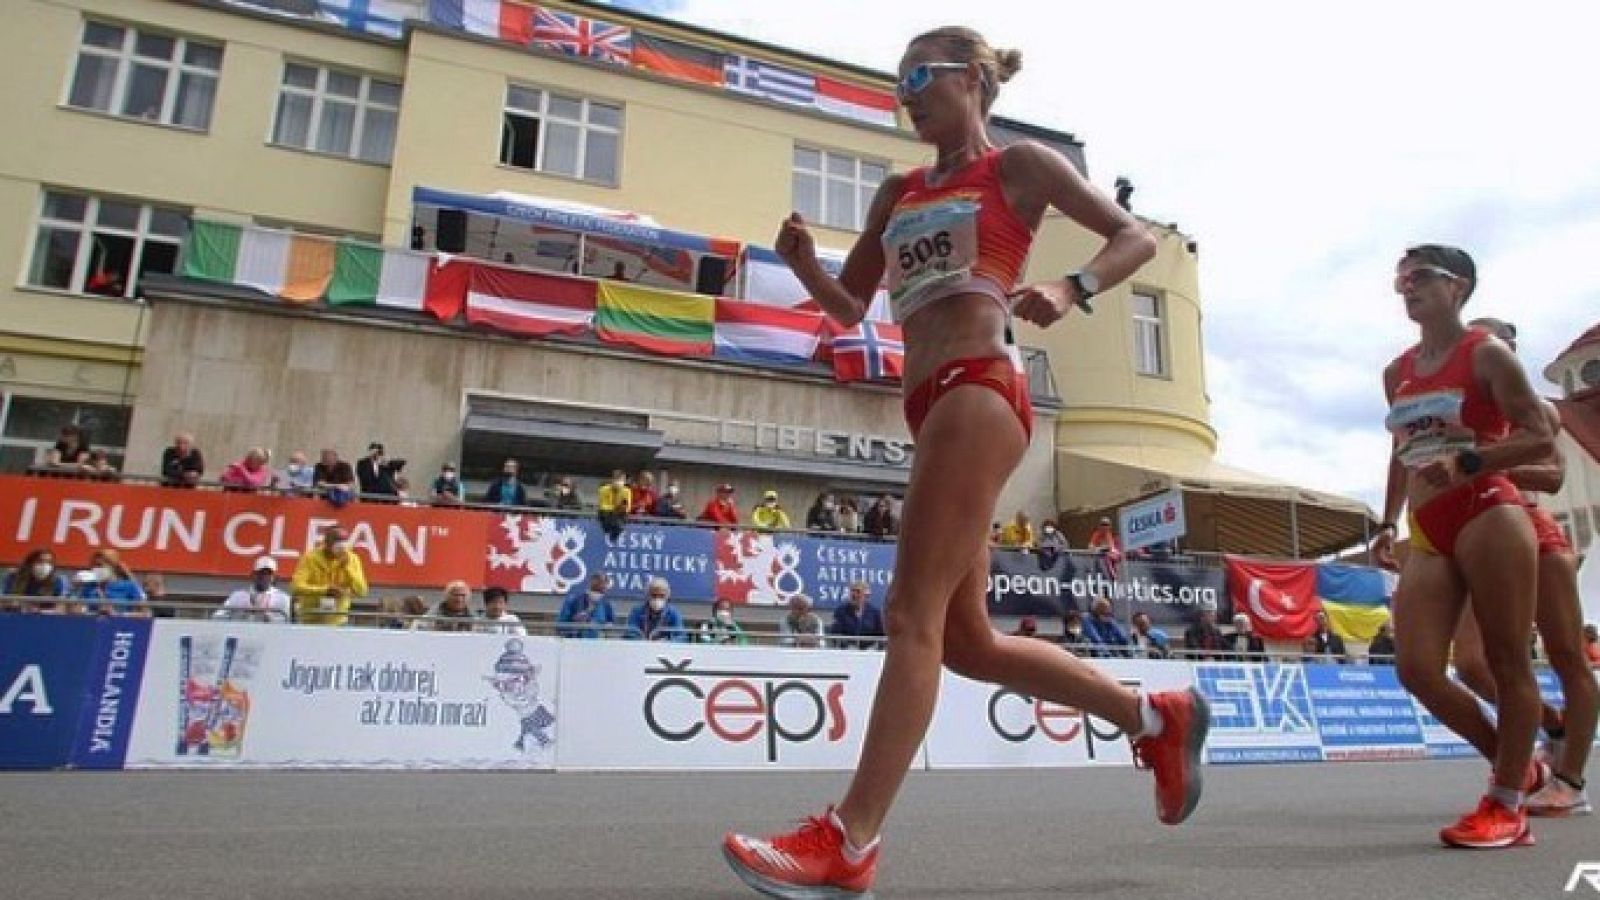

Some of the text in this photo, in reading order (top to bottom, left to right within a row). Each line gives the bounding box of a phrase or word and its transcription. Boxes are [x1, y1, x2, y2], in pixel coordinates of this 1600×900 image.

[899, 230, 953, 270] 506
[16, 497, 38, 542] I
[54, 499, 206, 554] RUN
[604, 551, 708, 574] ATLETICKÝ
[819, 585, 850, 602] SVA
[985, 573, 1218, 610] pean-athltics.org
[91, 631, 134, 752] HOLLANDIA
[282, 658, 341, 694] Jogurt
[347, 661, 377, 691] tak
[399, 697, 437, 725] toho
